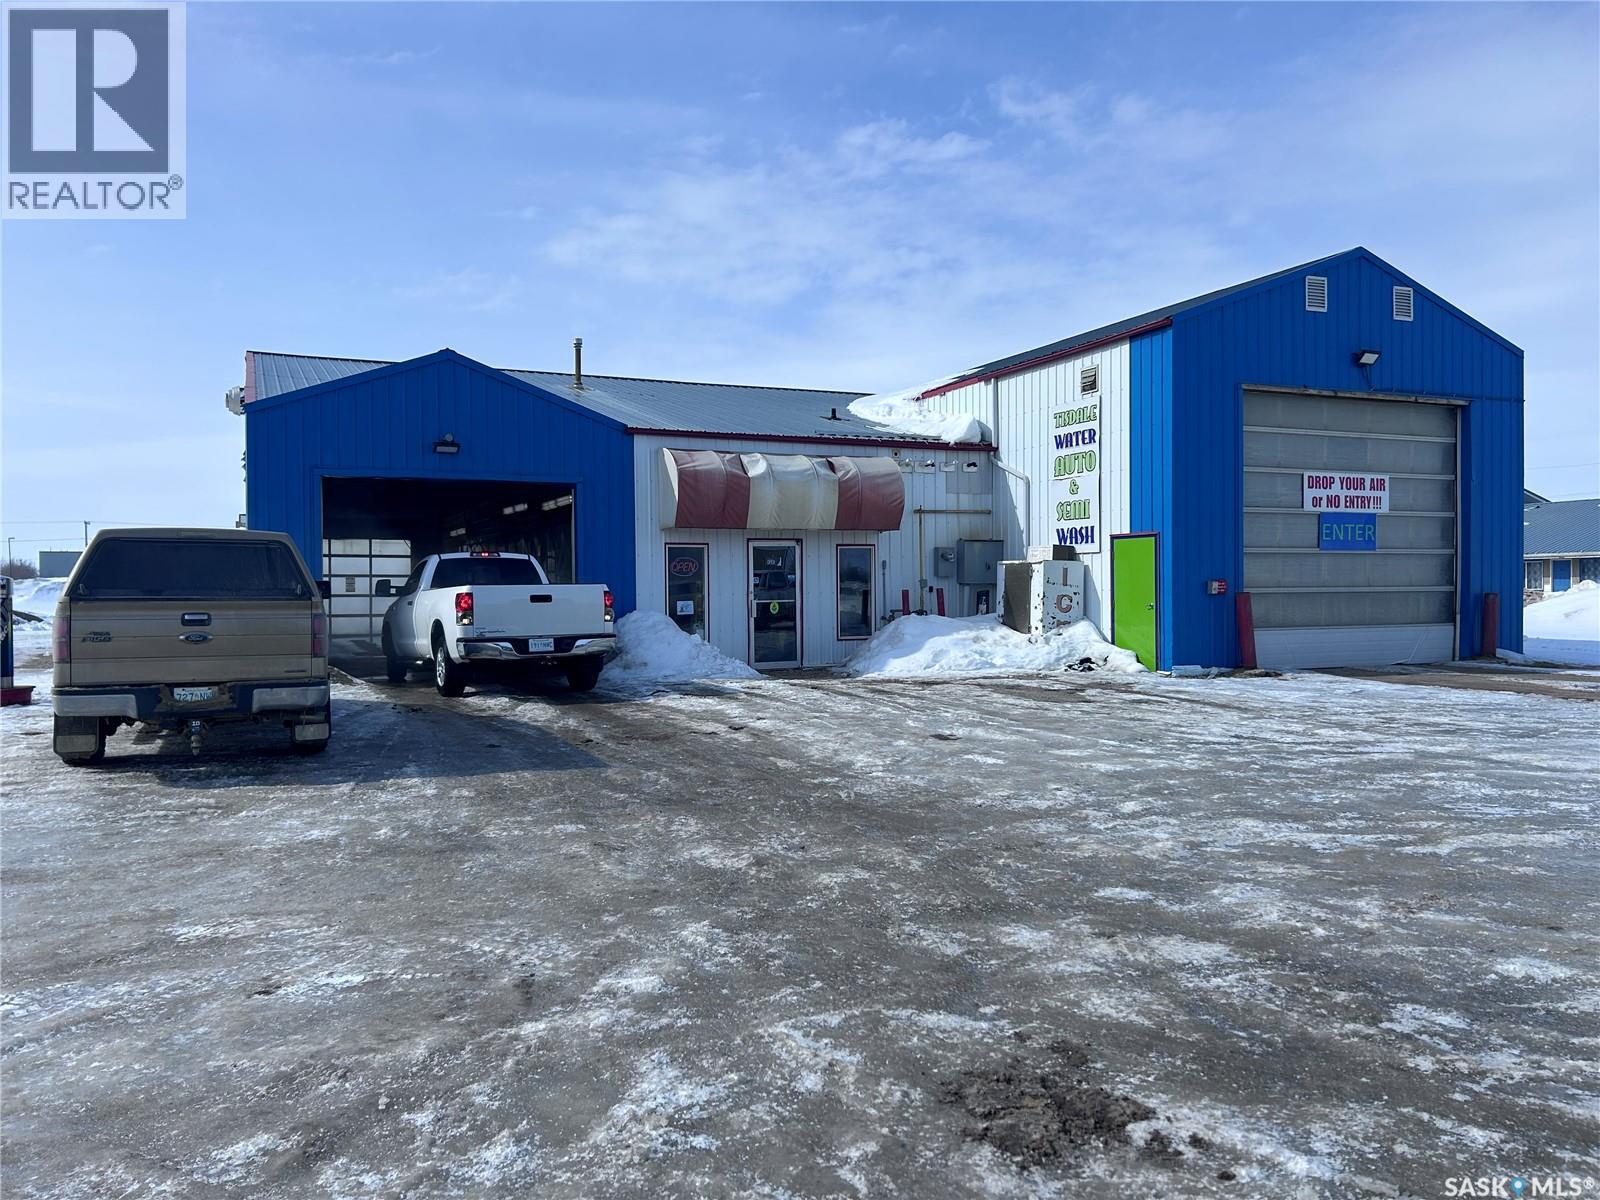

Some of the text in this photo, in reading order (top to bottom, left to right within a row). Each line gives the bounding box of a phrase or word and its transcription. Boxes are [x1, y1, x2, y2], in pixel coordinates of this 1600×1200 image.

[1054, 404, 1097, 428] TISDALE
[1054, 428, 1097, 450] WATER
[1054, 450, 1097, 477] AUTO
[1069, 479, 1079, 495] &
[1307, 475, 1386, 492] DROP YOUR AIR
[1056, 499, 1091, 521] SEMI
[1311, 494, 1382, 510] or NO ENTRY!!!
[1056, 525, 1095, 546] WASH
[1322, 523, 1375, 541] ENTER
[672, 560, 698, 572] OPEN
